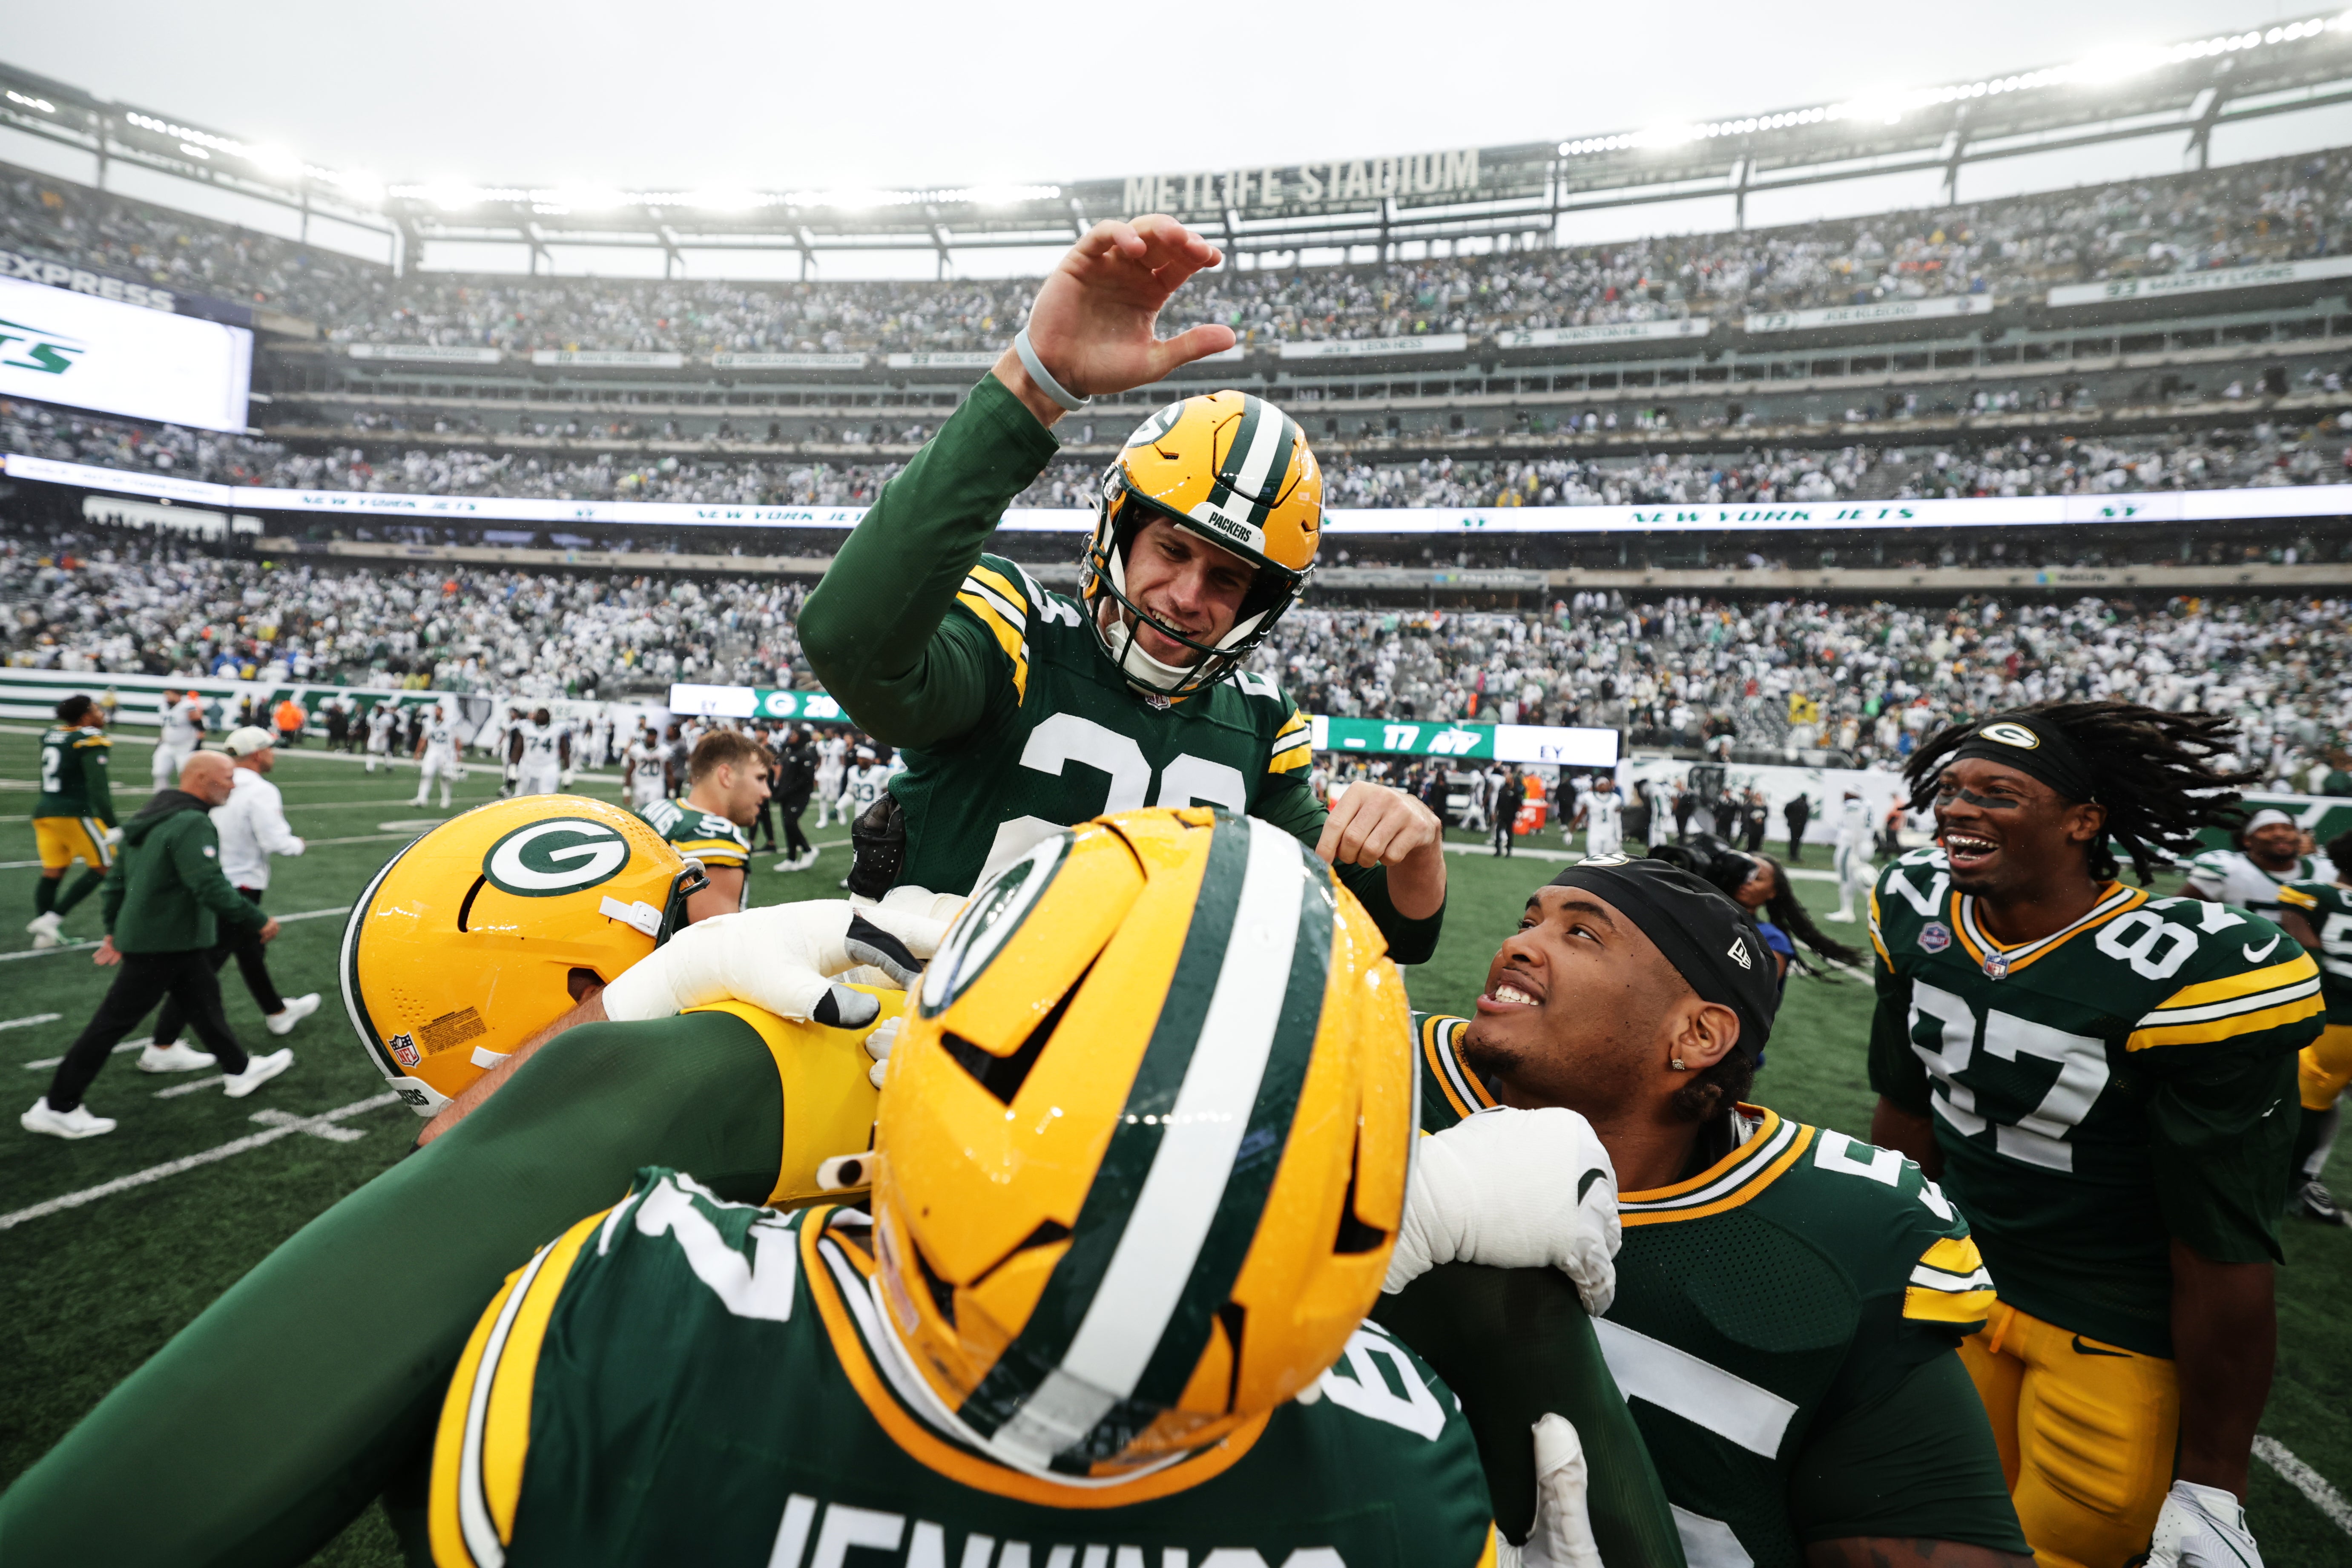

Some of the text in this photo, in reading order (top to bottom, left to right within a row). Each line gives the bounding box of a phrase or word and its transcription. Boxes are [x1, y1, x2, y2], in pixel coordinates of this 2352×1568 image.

[1123, 147, 1481, 214] METLIFE STADIUM
[0, 251, 176, 313] EXPRESS
[1394, 339, 1424, 349] HESS
[695, 510, 741, 519] NEW
[754, 511, 813, 521] YORK
[1630, 508, 1915, 522] NEW YORK JETS
[1208, 511, 1252, 542] PACKERS
[701, 701, 716, 709] EY
[803, 695, 844, 718] 20
[1383, 725, 1420, 750] 17
[1982, 724, 2036, 748] G
[526, 737, 552, 753] 74
[1541, 746, 1564, 759] EY
[1600, 809, 1608, 823] 1
[490, 821, 625, 890] G
[1986, 962, 2005, 976] NFL
[432, 1011, 455, 1022] WARNING
[396, 1047, 417, 1063] NFL
[1908, 977, 2110, 1174] 87
